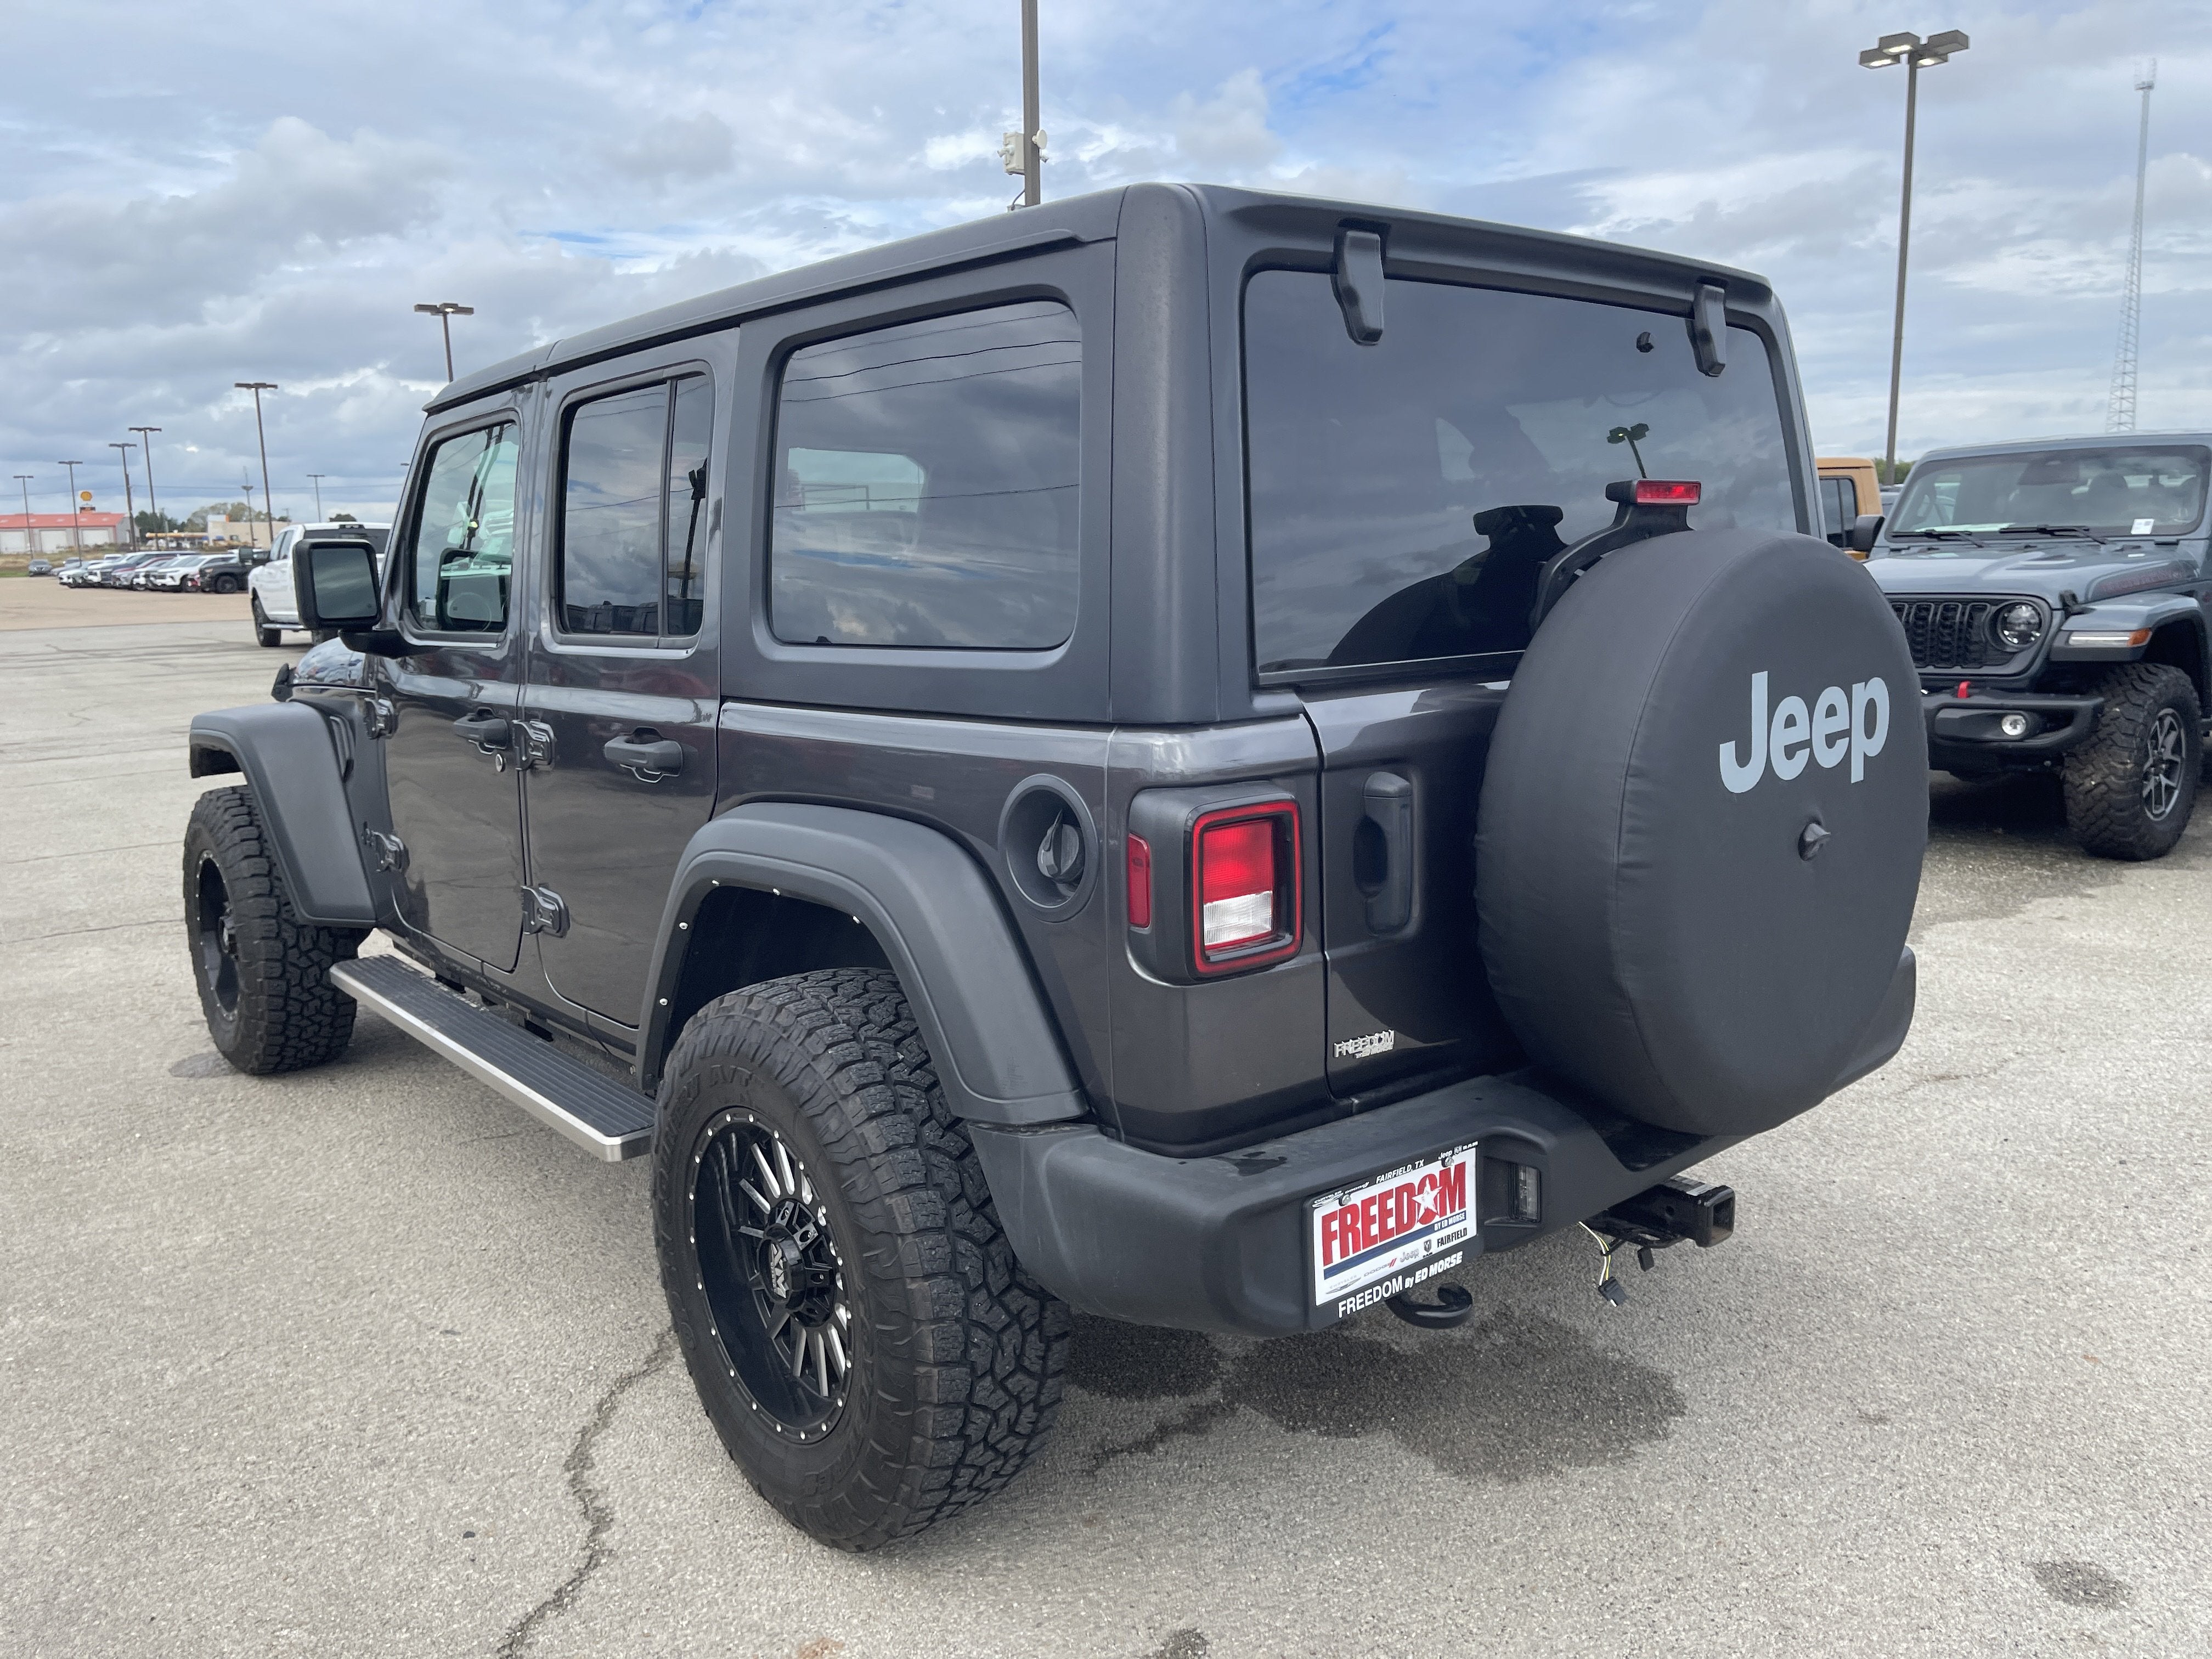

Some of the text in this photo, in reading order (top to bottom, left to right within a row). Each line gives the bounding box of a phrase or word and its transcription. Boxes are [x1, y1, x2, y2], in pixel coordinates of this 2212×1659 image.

[1719, 670, 1890, 794] Jeep
[1333, 1029, 1395, 1058] FREEDOM
[1438, 1150, 1453, 1160] Jeep
[1376, 1159, 1424, 1184] FAIRFIELD, TX
[1321, 1161, 1466, 1267] FREEDOM
[1441, 1219, 1448, 1228] ED
[1448, 1212, 1465, 1226] MORSE
[1437, 1227, 1467, 1248] FAIRFIELD
[1400, 1248, 1420, 1262] Jeep
[1338, 1275, 1403, 1318] FREEDOM
[1414, 1267, 1429, 1284] ED
[1429, 1251, 1463, 1277] MORSE
